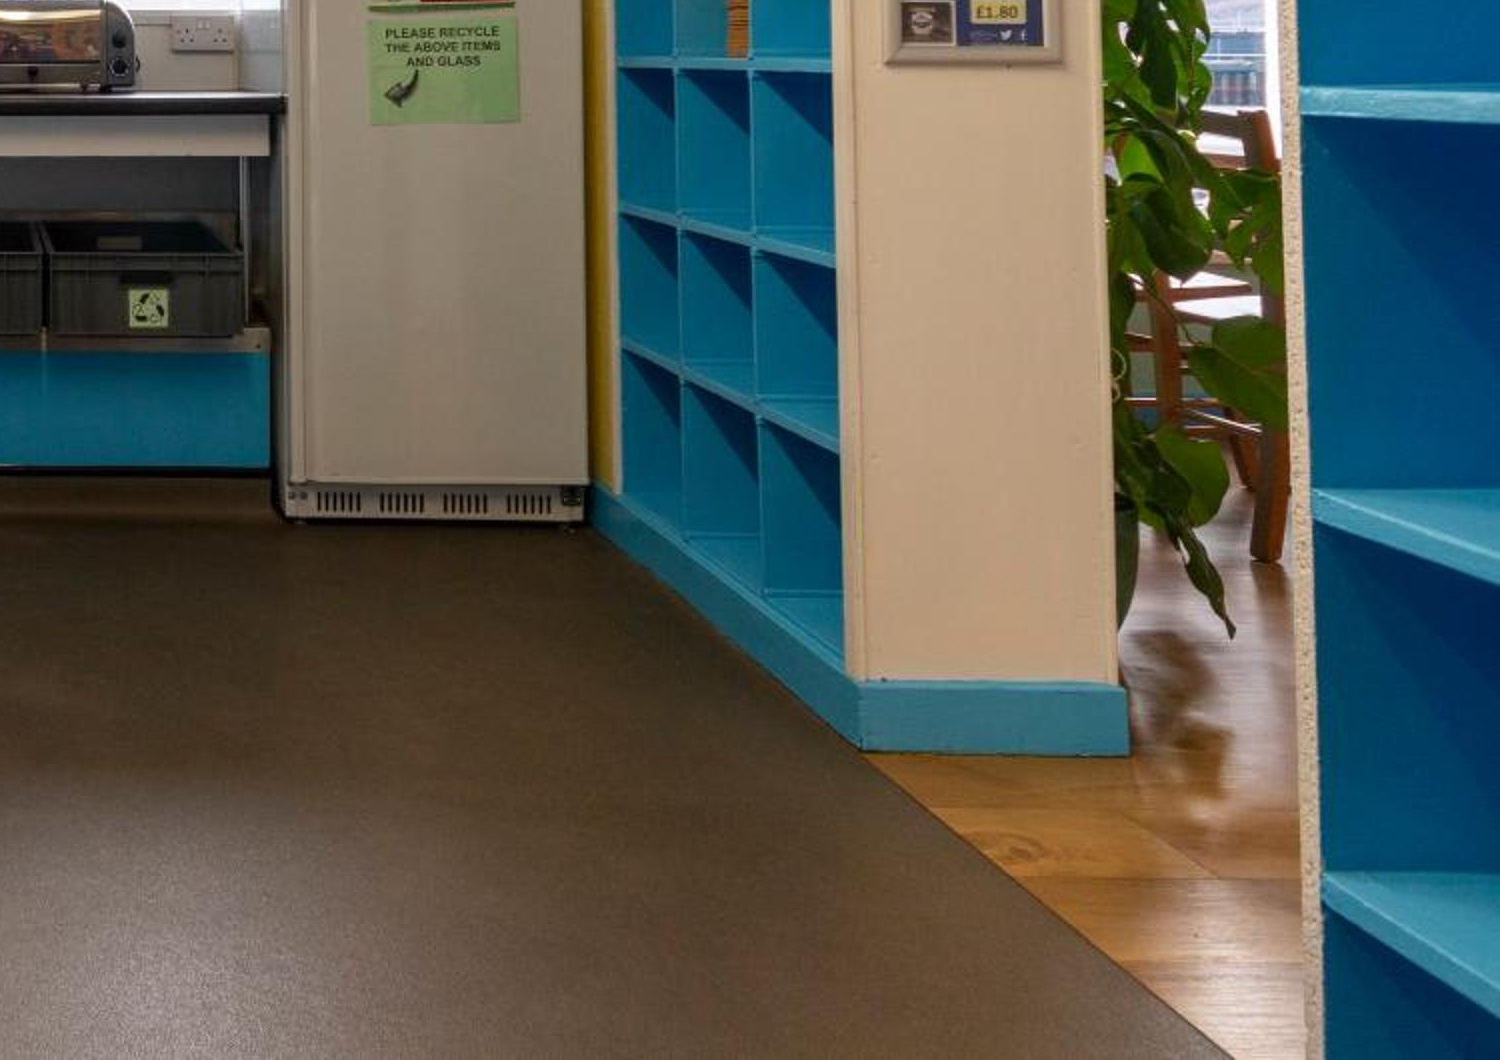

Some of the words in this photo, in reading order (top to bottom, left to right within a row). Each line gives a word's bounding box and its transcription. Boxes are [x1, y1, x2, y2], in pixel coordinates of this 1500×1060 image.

[975, 5, 1019, 20] £1.80
[384, 27, 437, 40] PLEASE
[438, 25, 501, 39] RECYCLE
[384, 42, 411, 54] THE
[413, 41, 460, 53] ABOVE
[461, 39, 502, 53] ITEMS
[405, 56, 434, 67] AND
[436, 55, 482, 67] GLASS
